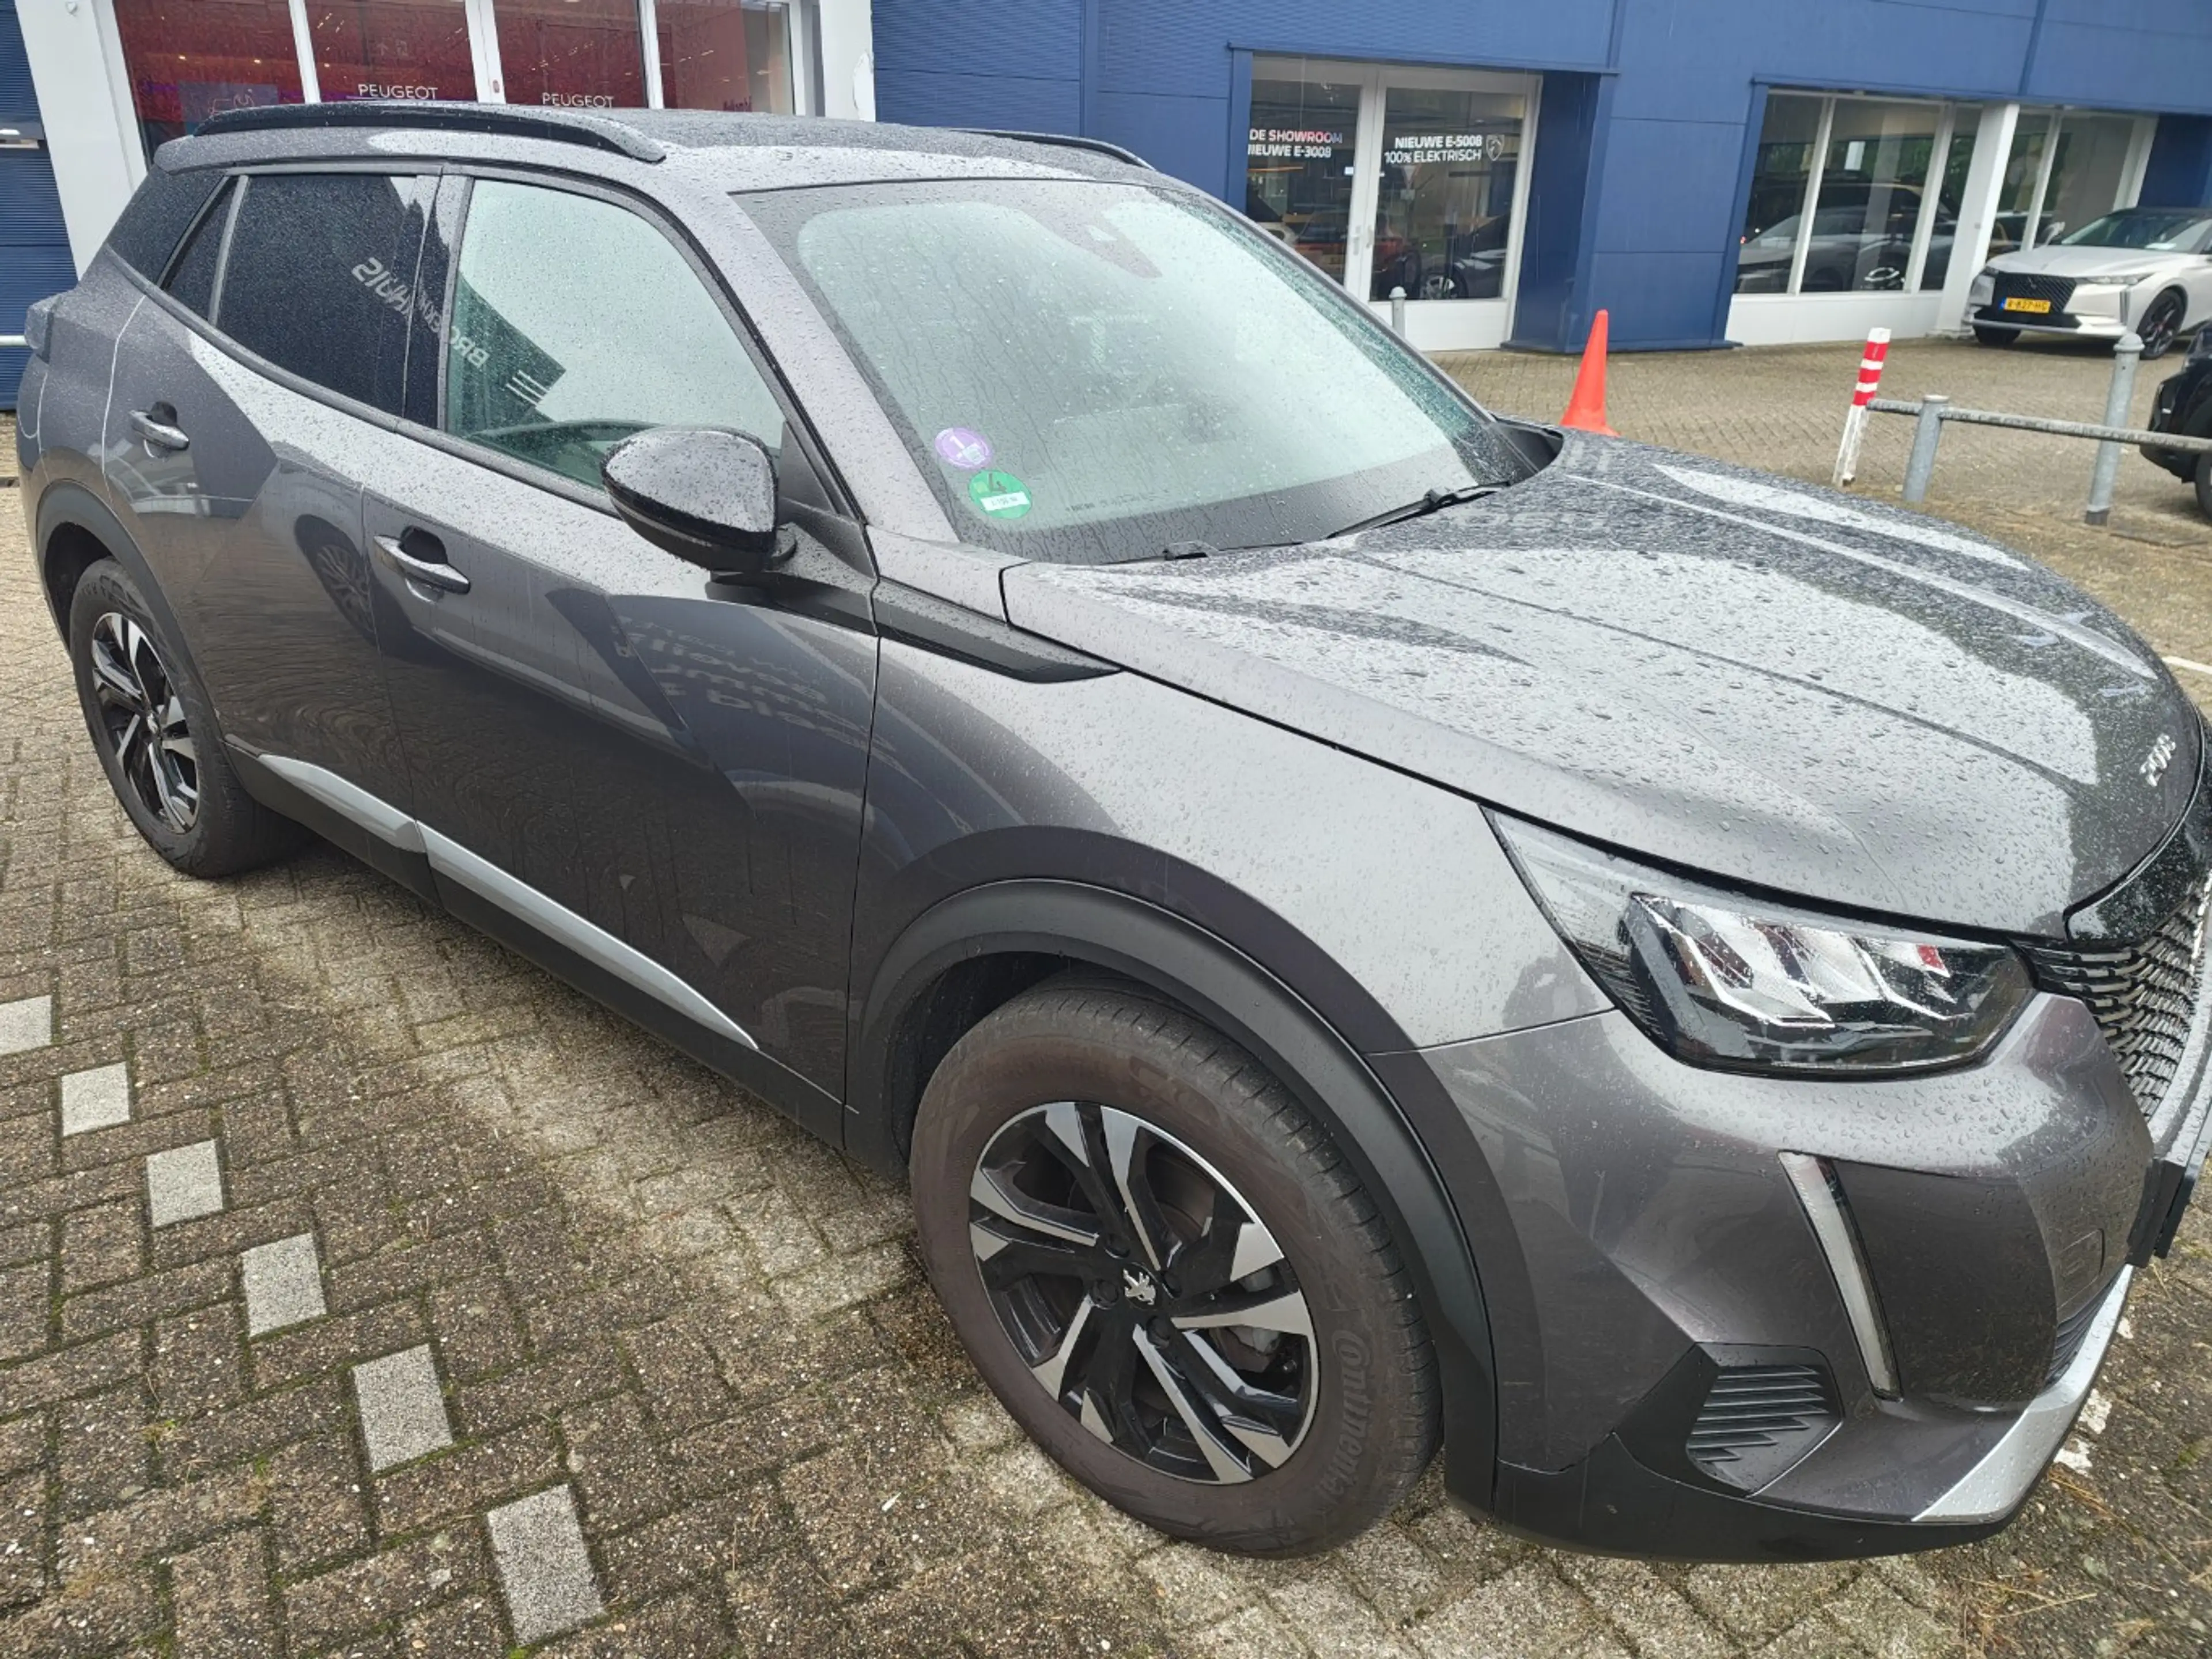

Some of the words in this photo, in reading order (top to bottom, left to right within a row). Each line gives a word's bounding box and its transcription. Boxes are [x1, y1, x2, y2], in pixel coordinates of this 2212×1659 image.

[358, 84, 438, 100] PEUGEOT
[542, 92, 614, 108] PEUGEOT
[1249, 128, 1266, 141] DE
[1268, 130, 1343, 143] SHOWROOM
[1395, 135, 1443, 149] NIEUWE
[1445, 135, 1483, 148] E-5008
[1294, 145, 1332, 158] E-3008
[1385, 150, 1411, 164] 100%
[1414, 149, 1482, 163] ELEKTRISCH
